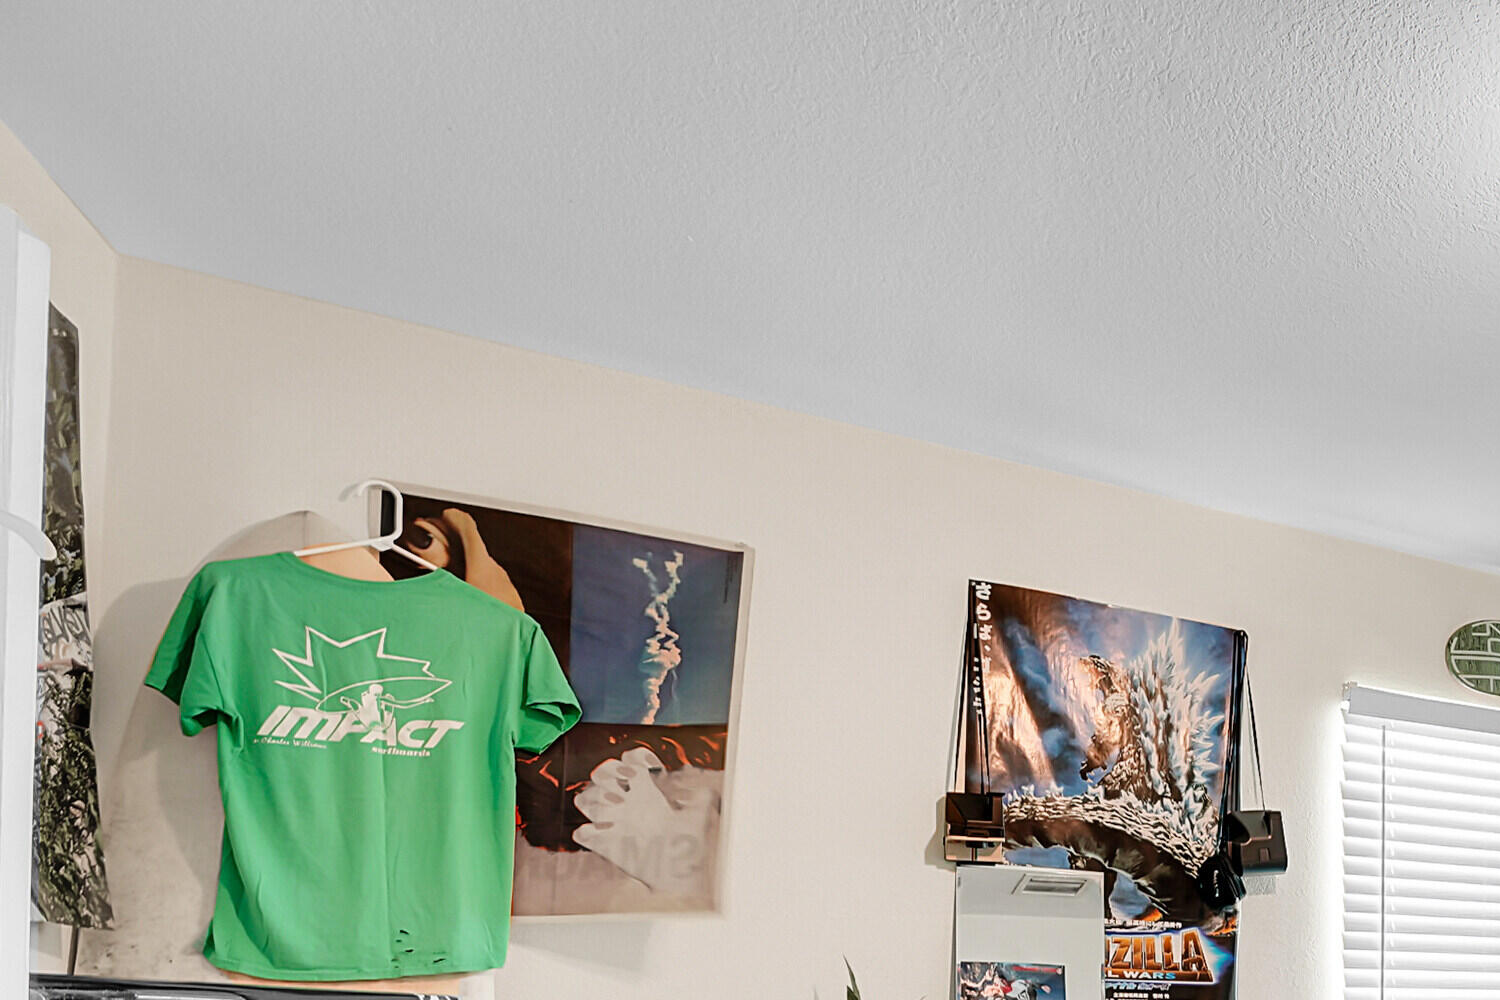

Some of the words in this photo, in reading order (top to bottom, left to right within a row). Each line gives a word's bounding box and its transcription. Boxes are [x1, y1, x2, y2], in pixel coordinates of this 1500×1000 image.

[256, 705, 465, 749] IMPACT
[1105, 928, 1209, 973] ZILLA
[1123, 970, 1177, 980] WARS
